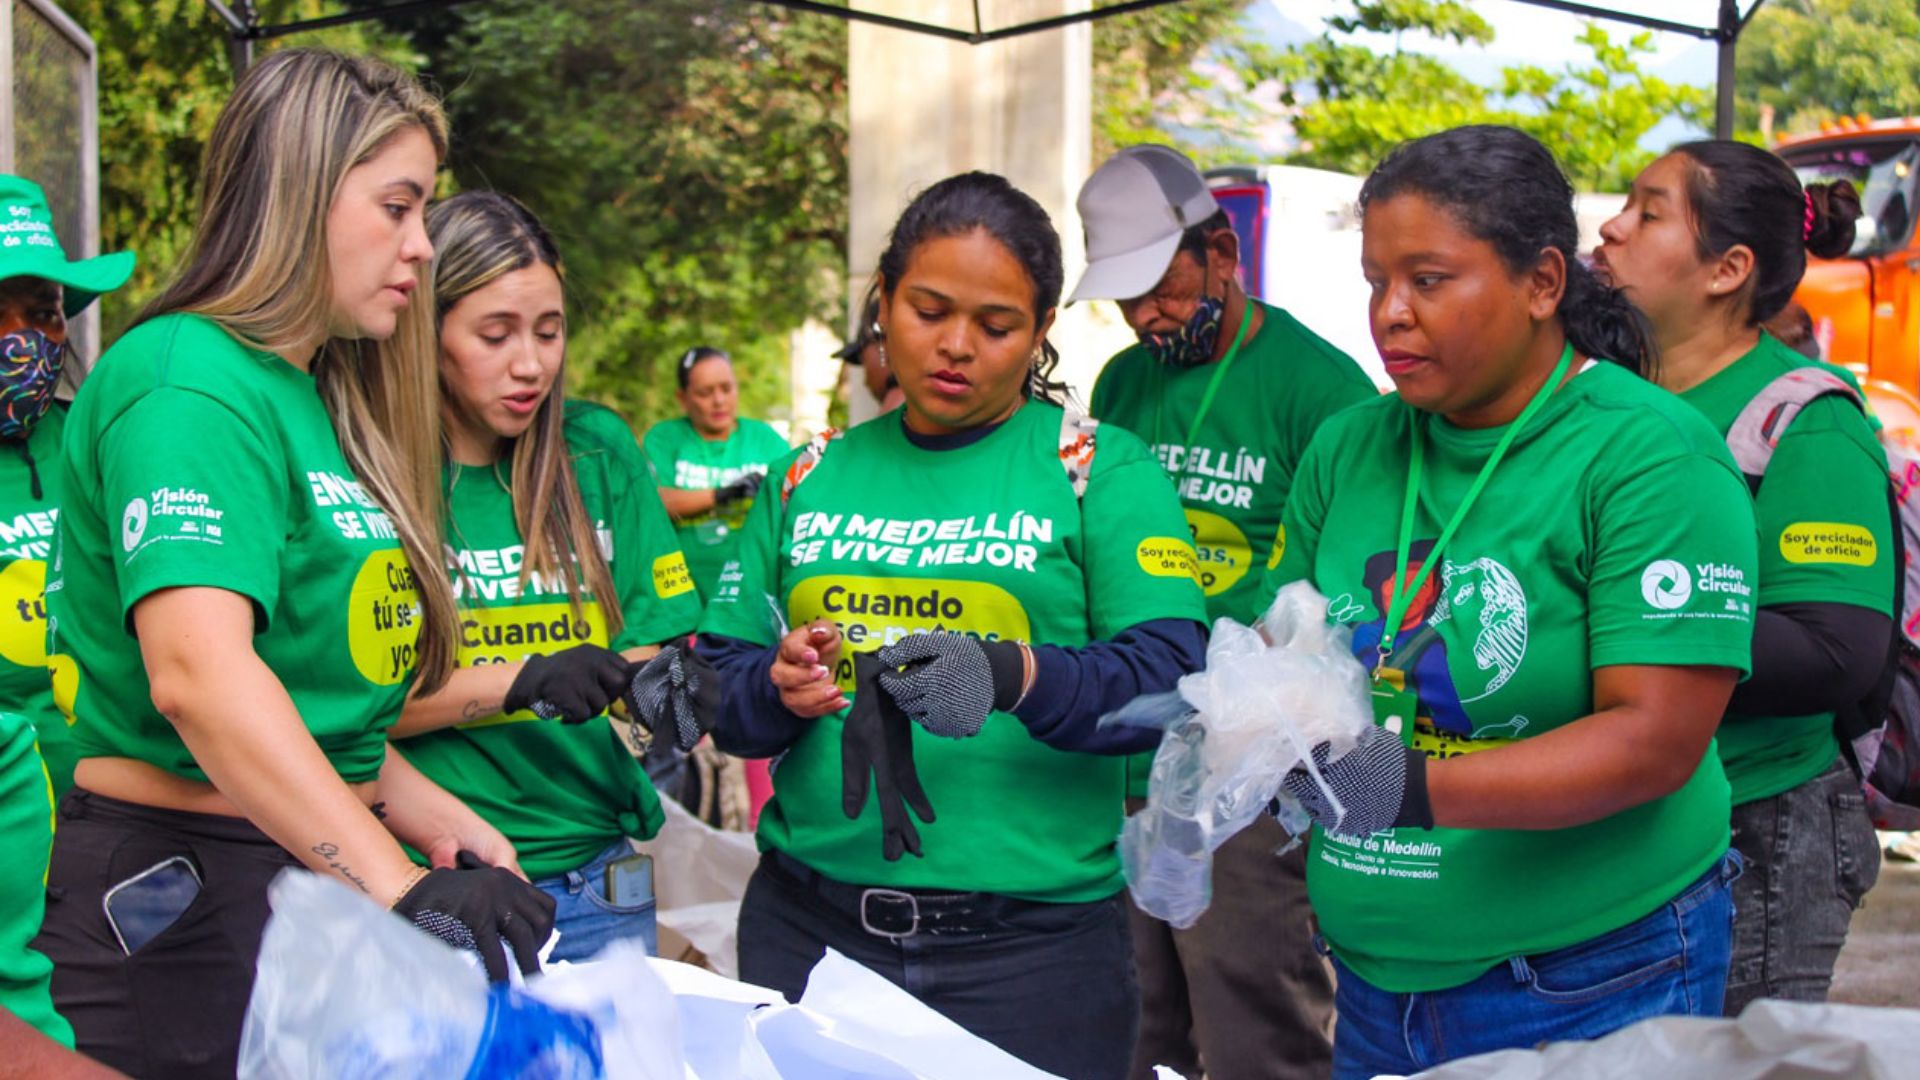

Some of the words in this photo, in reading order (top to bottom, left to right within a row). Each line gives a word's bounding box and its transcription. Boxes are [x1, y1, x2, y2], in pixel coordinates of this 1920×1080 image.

[151, 487, 209, 504] Visión
[151, 502, 224, 520] Circular
[333, 511, 368, 539] SE
[792, 511, 843, 544] EN
[844, 510, 1053, 546] MEDELLÍN
[1784, 533, 1809, 544] Soy
[1813, 532, 1873, 547] reciclador
[790, 540, 826, 568] SE
[831, 539, 913, 566] VIVE
[917, 541, 1038, 573] MEJOR
[1140, 546, 1164, 559] Soy
[1804, 545, 1821, 555] de
[1825, 545, 1860, 557] oficio
[1161, 560, 1176, 569] de
[1696, 562, 1744, 581] Visión
[1697, 578, 1751, 597] Circular
[822, 585, 964, 620] Cuando
[372, 596, 393, 632] tú
[461, 613, 592, 648] Cuando
[1363, 835, 1379, 852] de
[1383, 839, 1441, 857] Medellín
